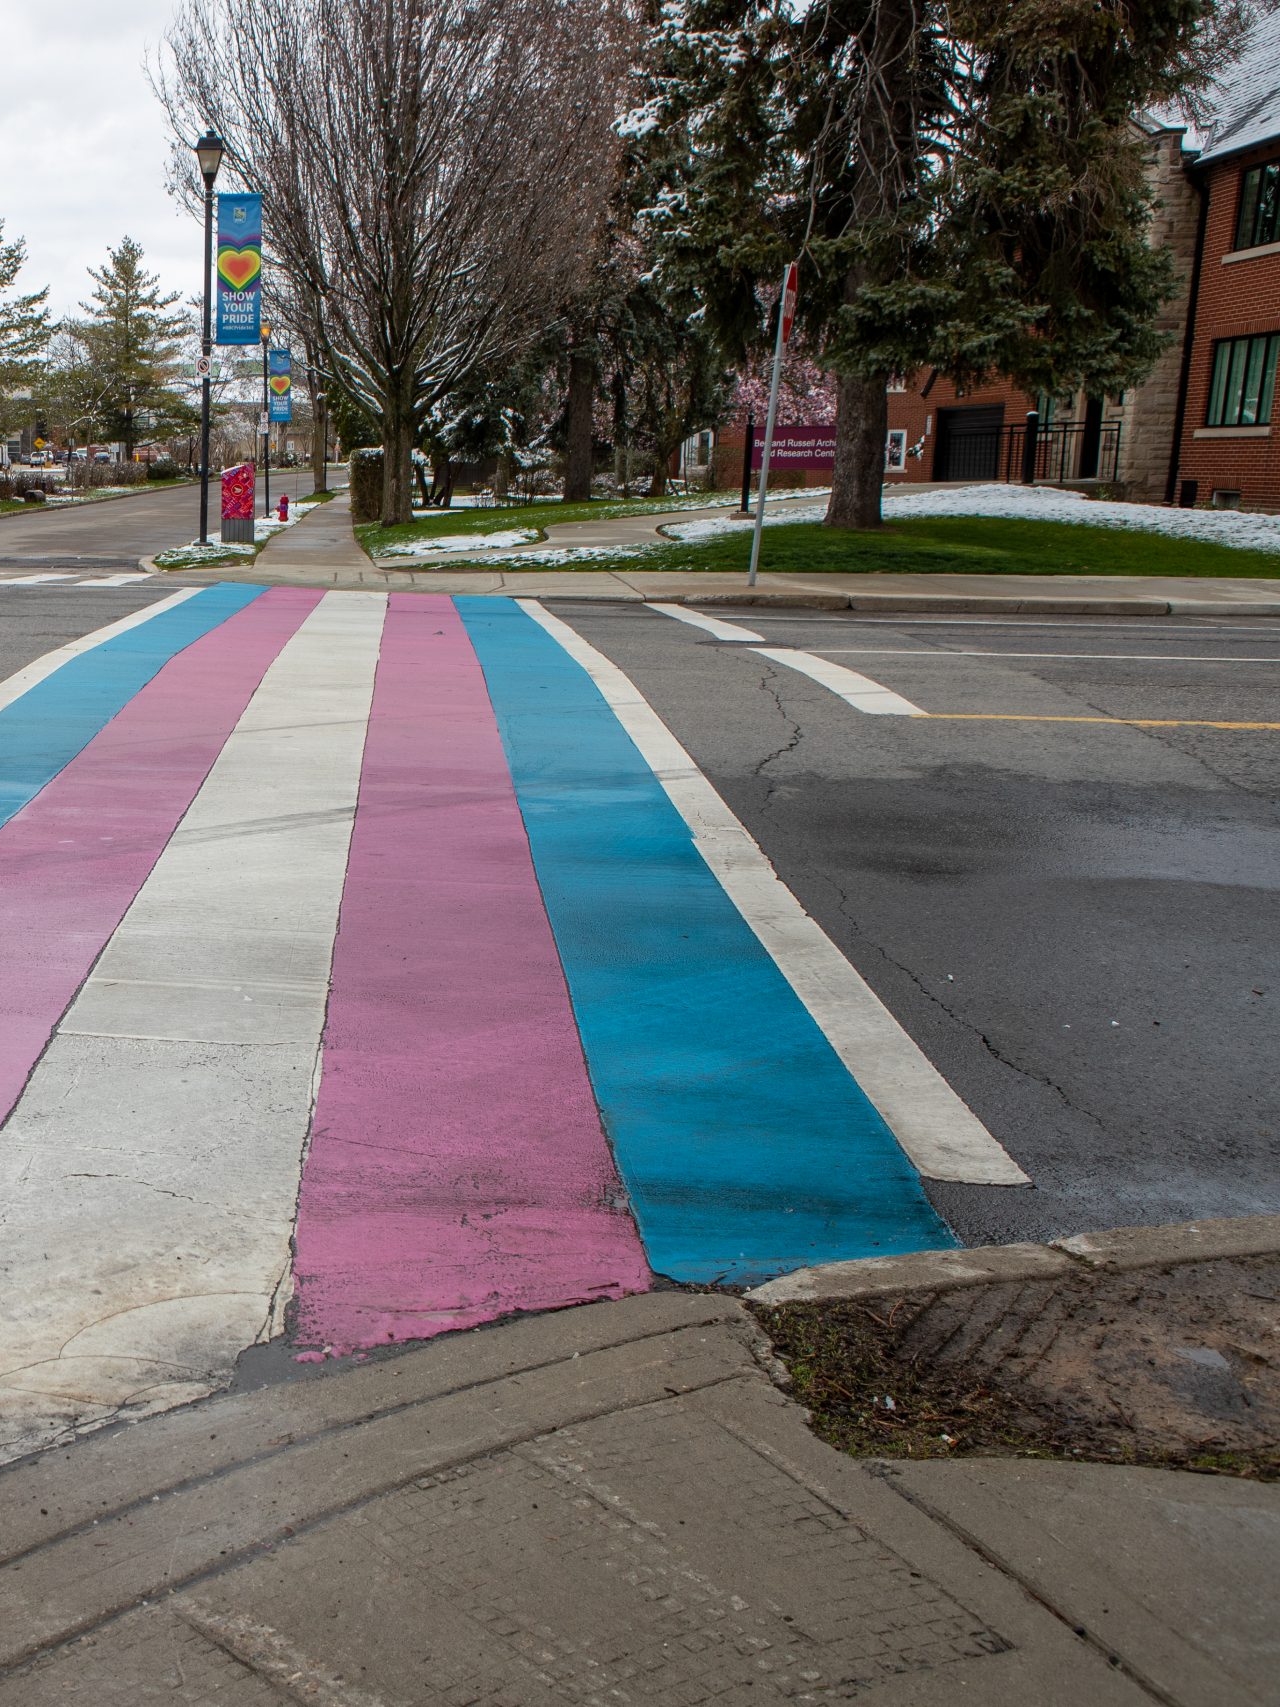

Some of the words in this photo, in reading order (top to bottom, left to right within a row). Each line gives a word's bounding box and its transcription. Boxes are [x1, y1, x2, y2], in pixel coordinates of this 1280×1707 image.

[222, 291, 255, 302] SHOW
[223, 302, 254, 313] YOUR
[222, 314, 255, 324] PRIDE
[754, 439, 786, 447] Beand
[787, 439, 815, 447] Russell
[816, 439, 837, 447] Archi
[777, 449, 813, 457] Research
[814, 449, 835, 457] Centr
